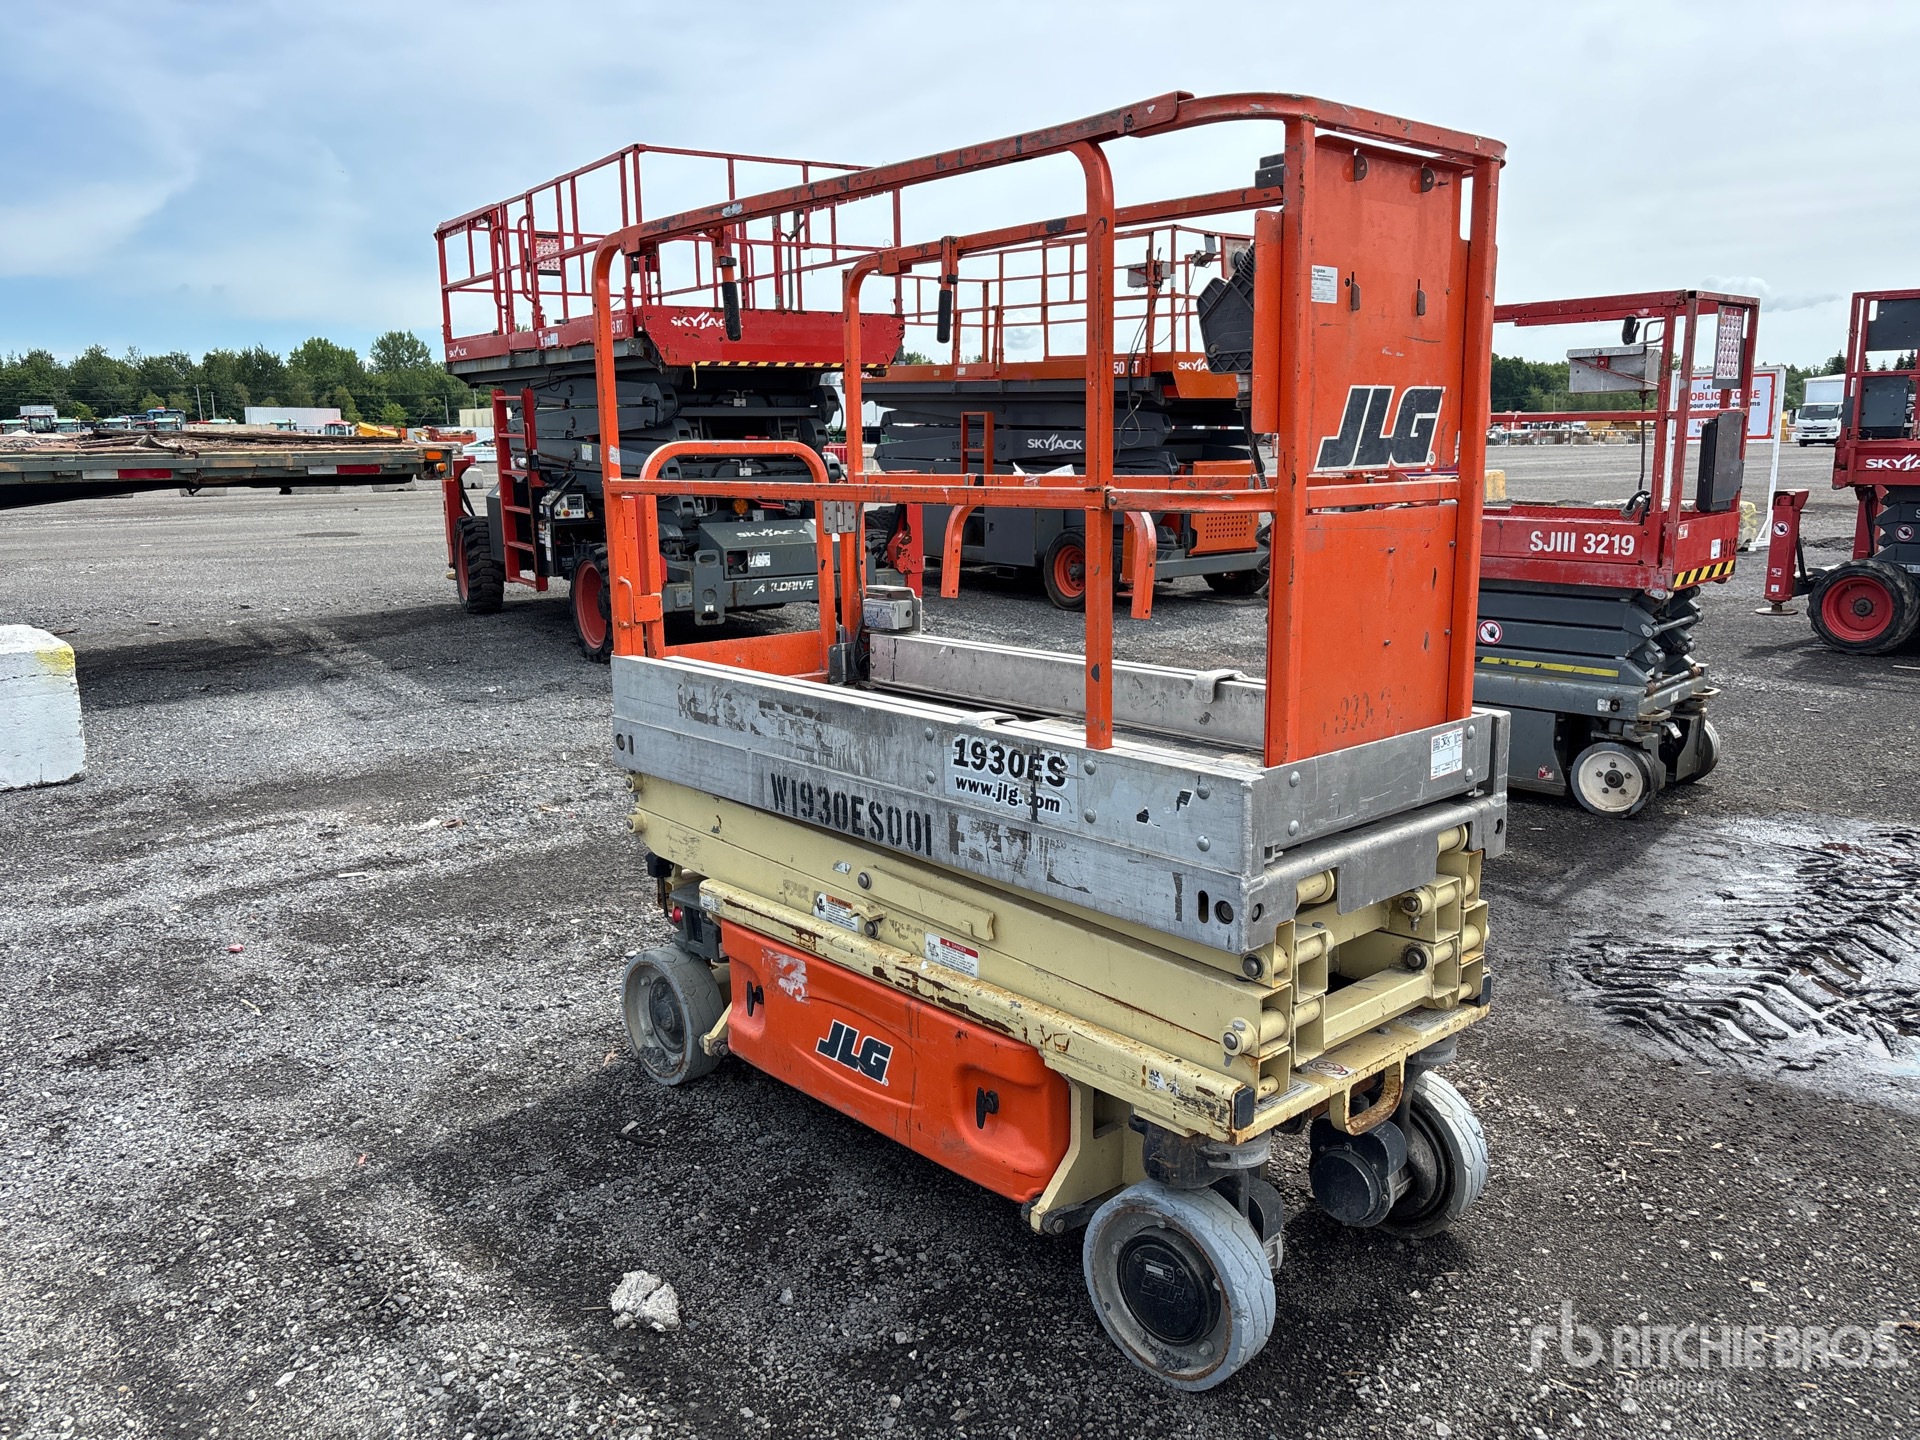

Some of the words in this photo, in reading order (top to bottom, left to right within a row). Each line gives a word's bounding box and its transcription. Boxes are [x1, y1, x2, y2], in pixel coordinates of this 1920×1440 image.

[671, 311, 744, 330] SKYJAC
[1178, 358, 1209, 372] SKYJA
[1690, 390, 1760, 401] OBLIGTOE
[1705, 401, 1720, 409] opér
[1313, 385, 1446, 472] JLG
[1027, 434, 1083, 452] SKYJACK
[1865, 454, 1920, 471] SKYJA
[1529, 530, 1577, 553] SJIII
[1582, 532, 1635, 556] 3219
[953, 738, 1069, 788] 1930ES
[815, 1018, 894, 1085] JLG
